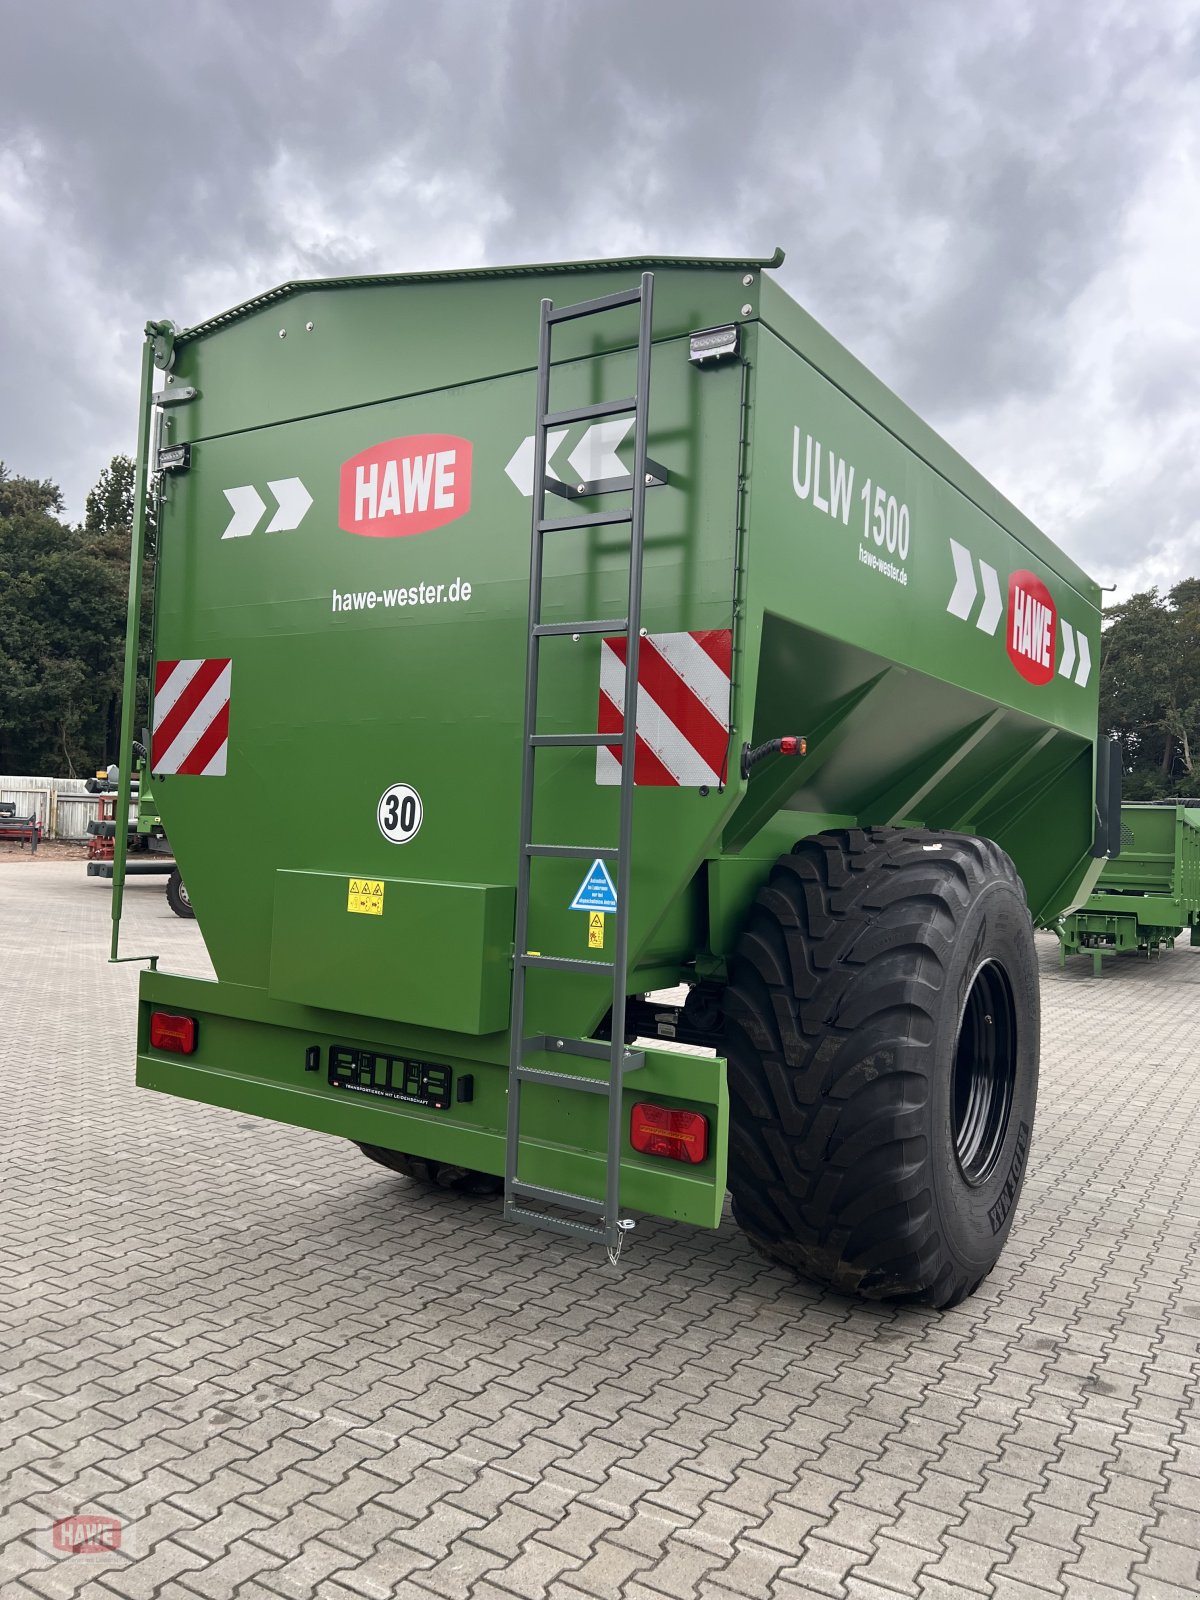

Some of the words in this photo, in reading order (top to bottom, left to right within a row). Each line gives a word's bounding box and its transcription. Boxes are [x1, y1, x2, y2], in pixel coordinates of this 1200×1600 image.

[354, 449, 456, 521] HAWE
[792, 425, 855, 526] ULW
[861, 478, 910, 561] 1500
[858, 542, 908, 586] hawe-wester.de
[332, 577, 472, 612] hawe-wester.de
[1012, 585, 1053, 668] HAWE
[384, 794, 416, 832] 30
[346, 1084, 385, 1096] TRANSPORTIEREN
